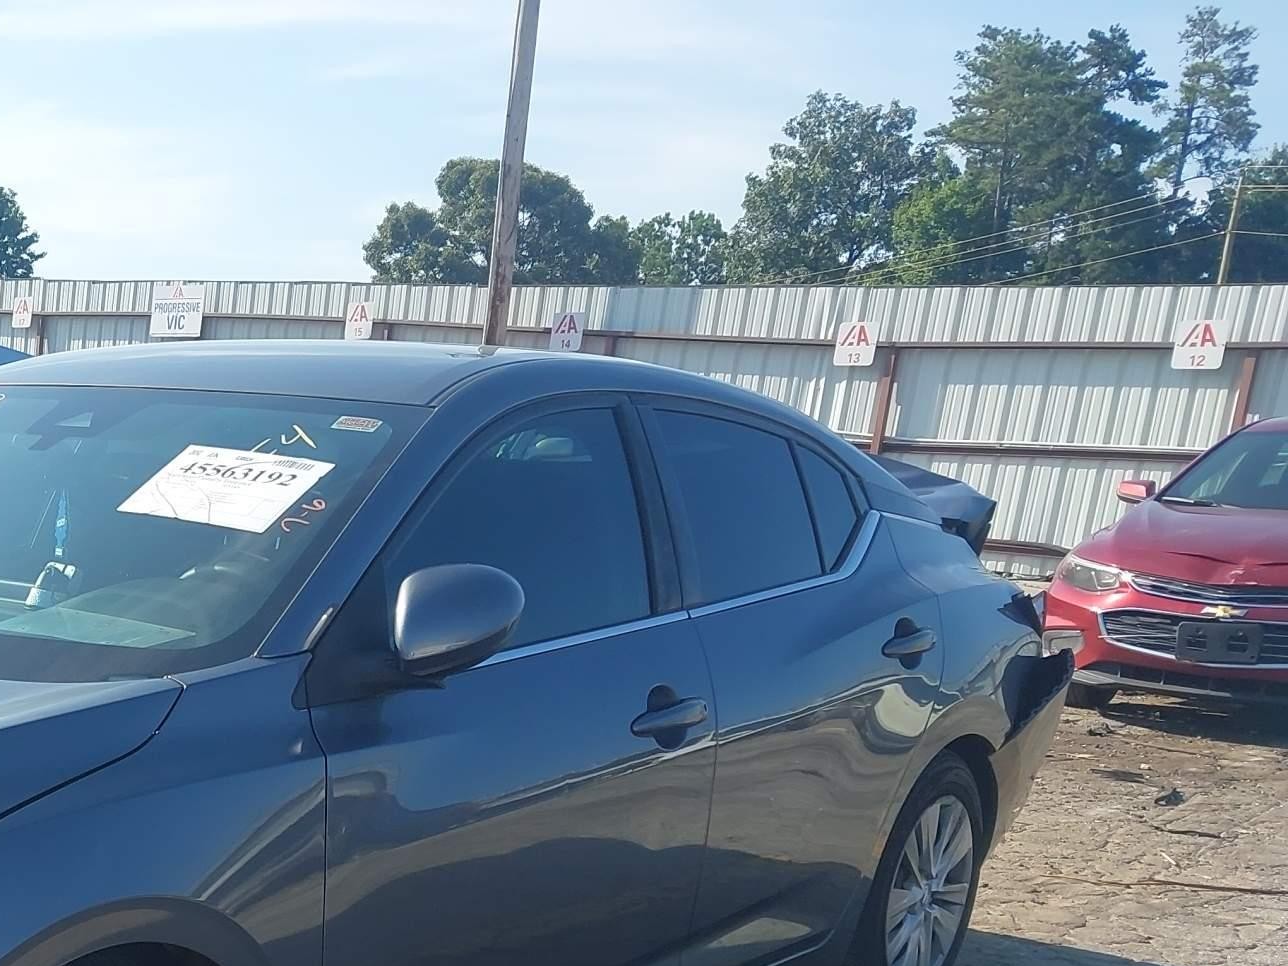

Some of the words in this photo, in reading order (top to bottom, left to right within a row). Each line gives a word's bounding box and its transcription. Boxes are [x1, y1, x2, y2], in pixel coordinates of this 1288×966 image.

[154, 302, 201, 313] PROGRESSIVE
[167, 314, 186, 330] VIC
[354, 327, 363, 337] 15
[561, 339, 571, 349] 14
[847, 352, 861, 364] 13
[1189, 354, 1206, 367] 12
[179, 461, 298, 487] 45563192
